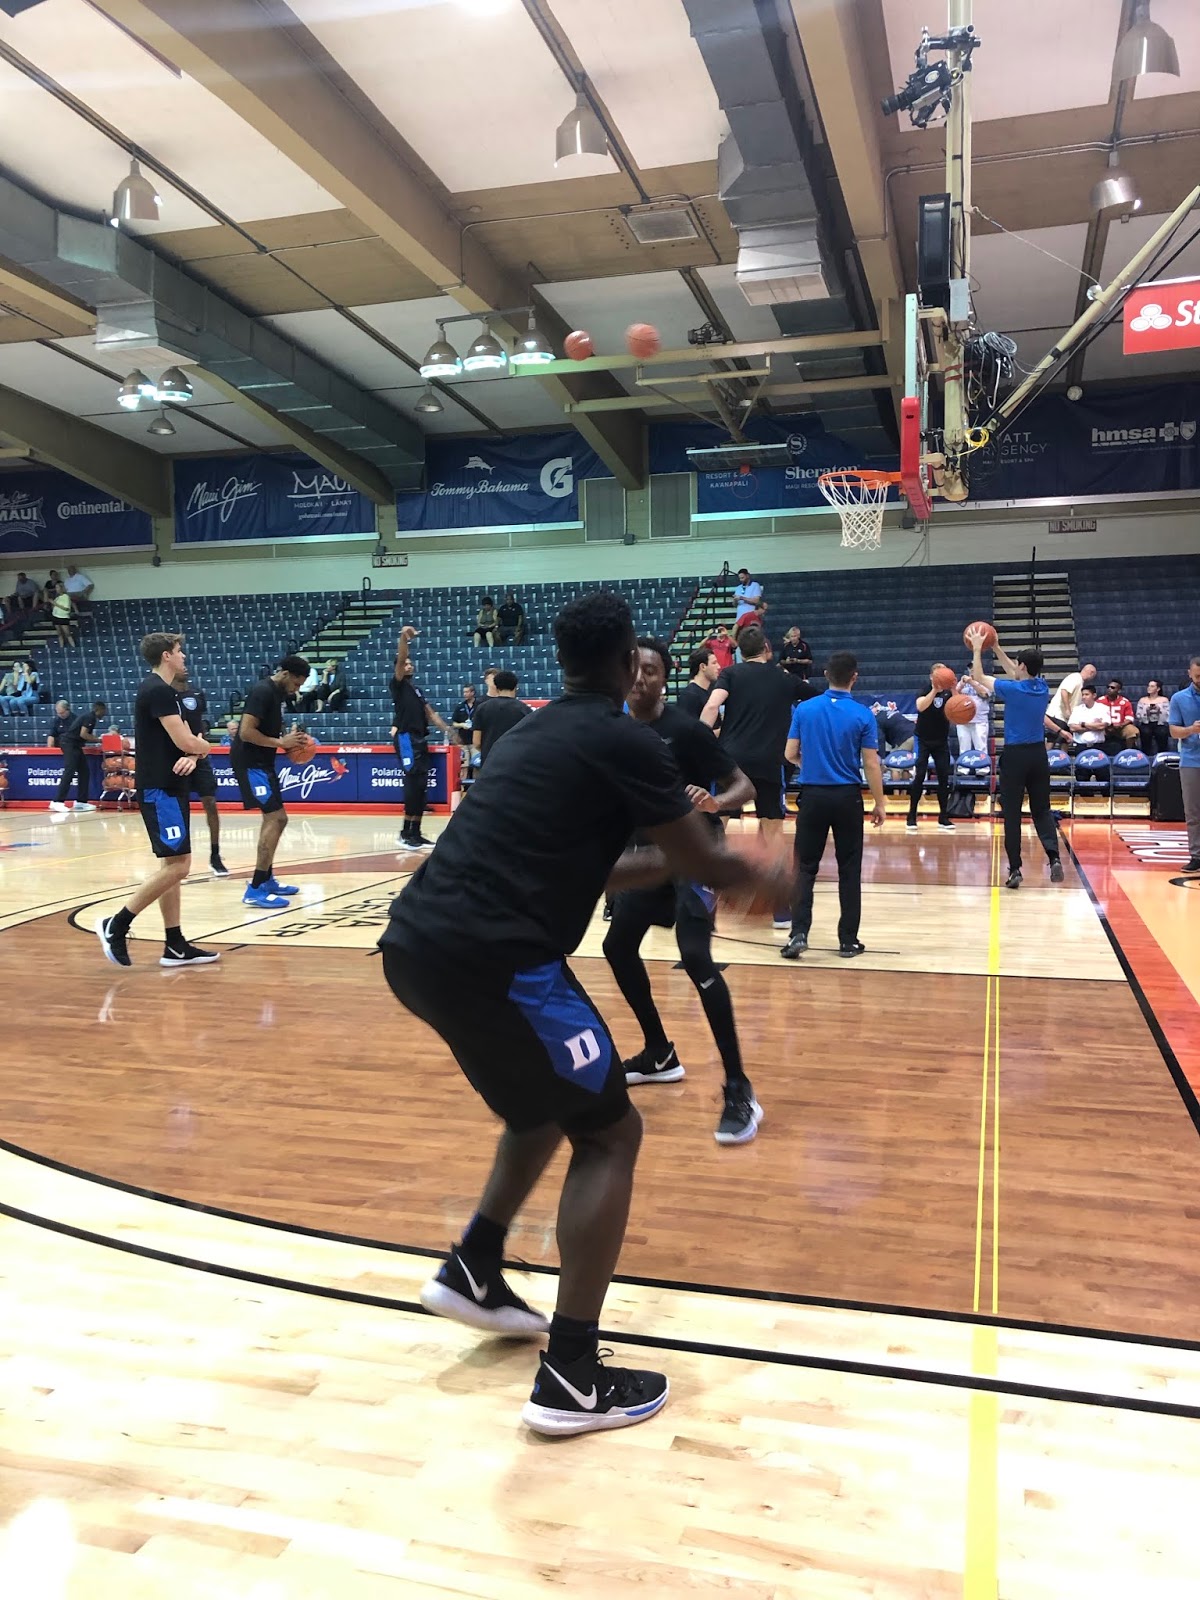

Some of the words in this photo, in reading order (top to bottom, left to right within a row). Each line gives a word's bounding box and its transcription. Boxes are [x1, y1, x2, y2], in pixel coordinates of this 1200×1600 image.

[1091, 427, 1157, 443] hmsa
[982, 443, 1047, 457] RGENCY
[540, 457, 574, 498] G
[56, 501, 125, 520] Continental
[28, 778, 78, 786] SUNGLE
[278, 767, 301, 788] Maui
[301, 764, 335, 799] Jim
[371, 778, 437, 787] SUNGLES
[563, 1028, 601, 1071] D
